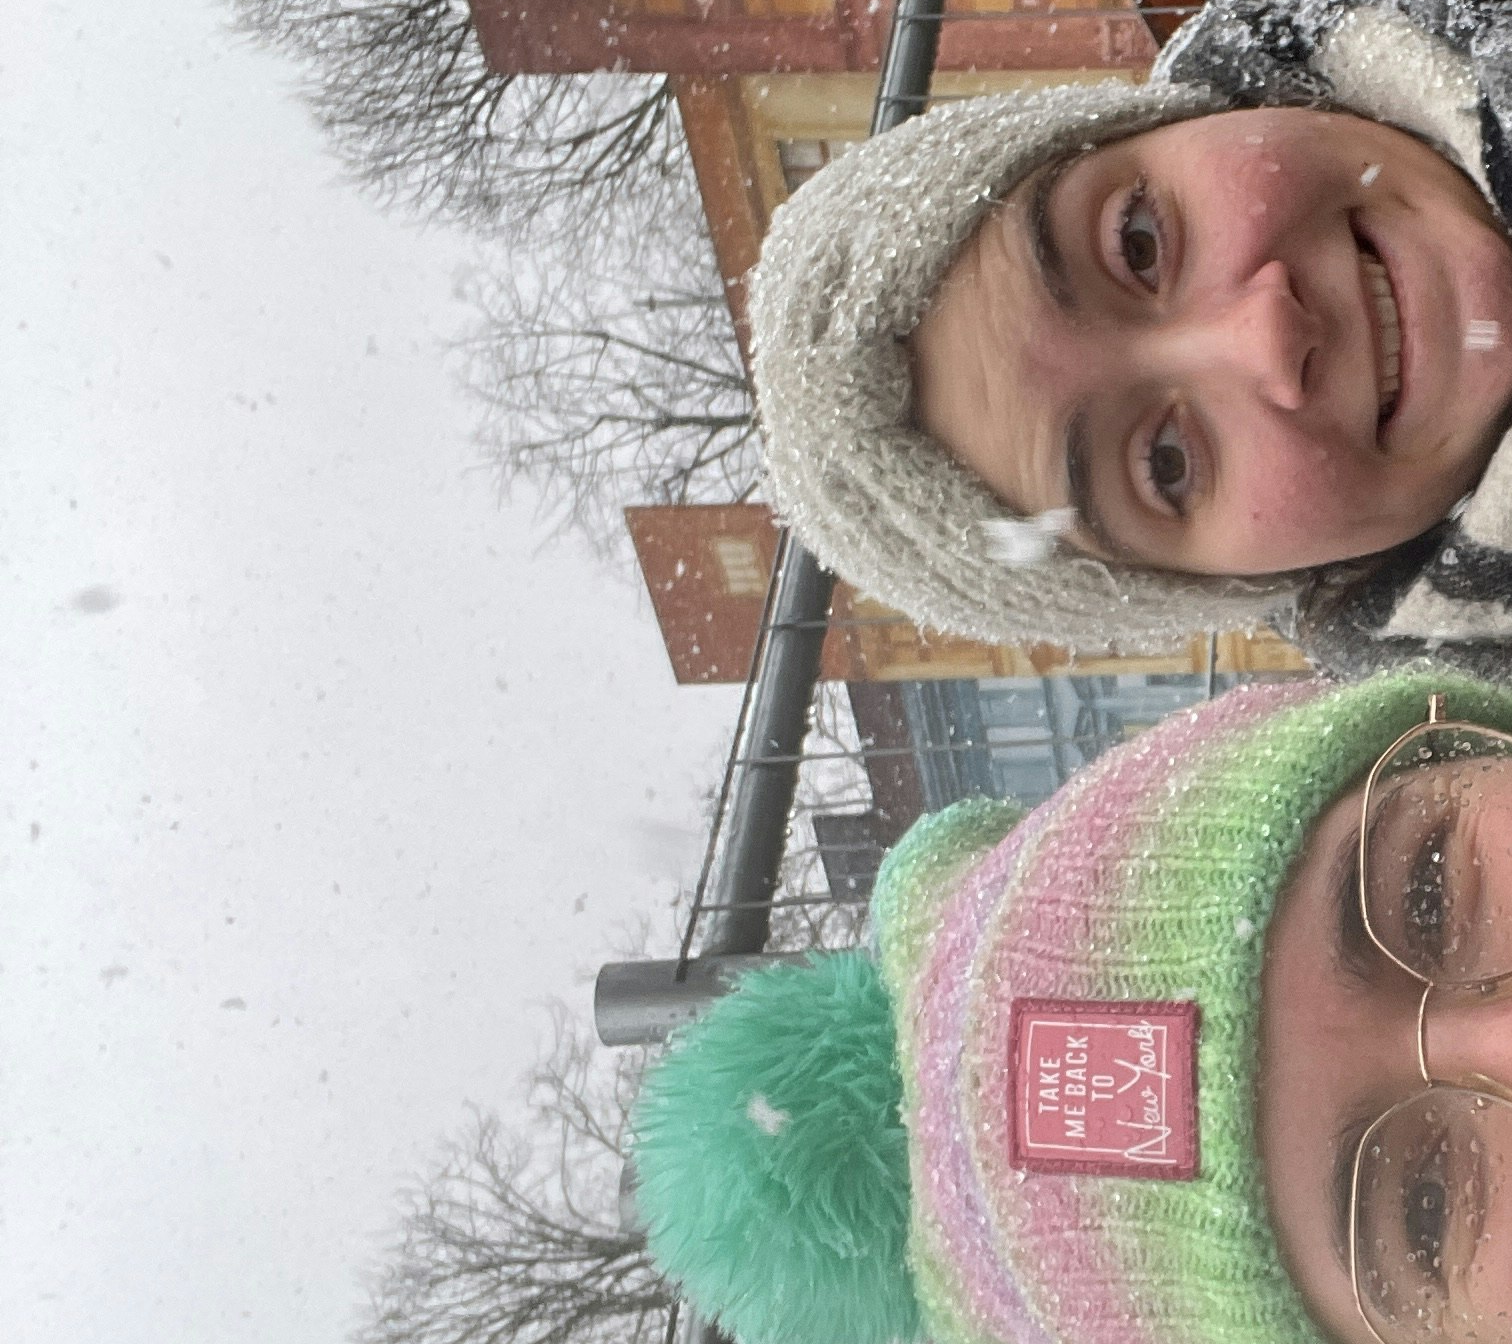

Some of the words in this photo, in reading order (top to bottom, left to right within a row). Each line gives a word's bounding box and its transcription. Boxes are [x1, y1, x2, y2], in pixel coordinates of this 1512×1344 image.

[1038, 1056, 1061, 1114] TAKE
[1064, 1034, 1089, 1097] BACK
[1113, 1019, 1172, 1095] York
[1091, 1074, 1115, 1102] TO
[1064, 1103, 1087, 1138] ME
[1115, 1084, 1178, 1164] New
